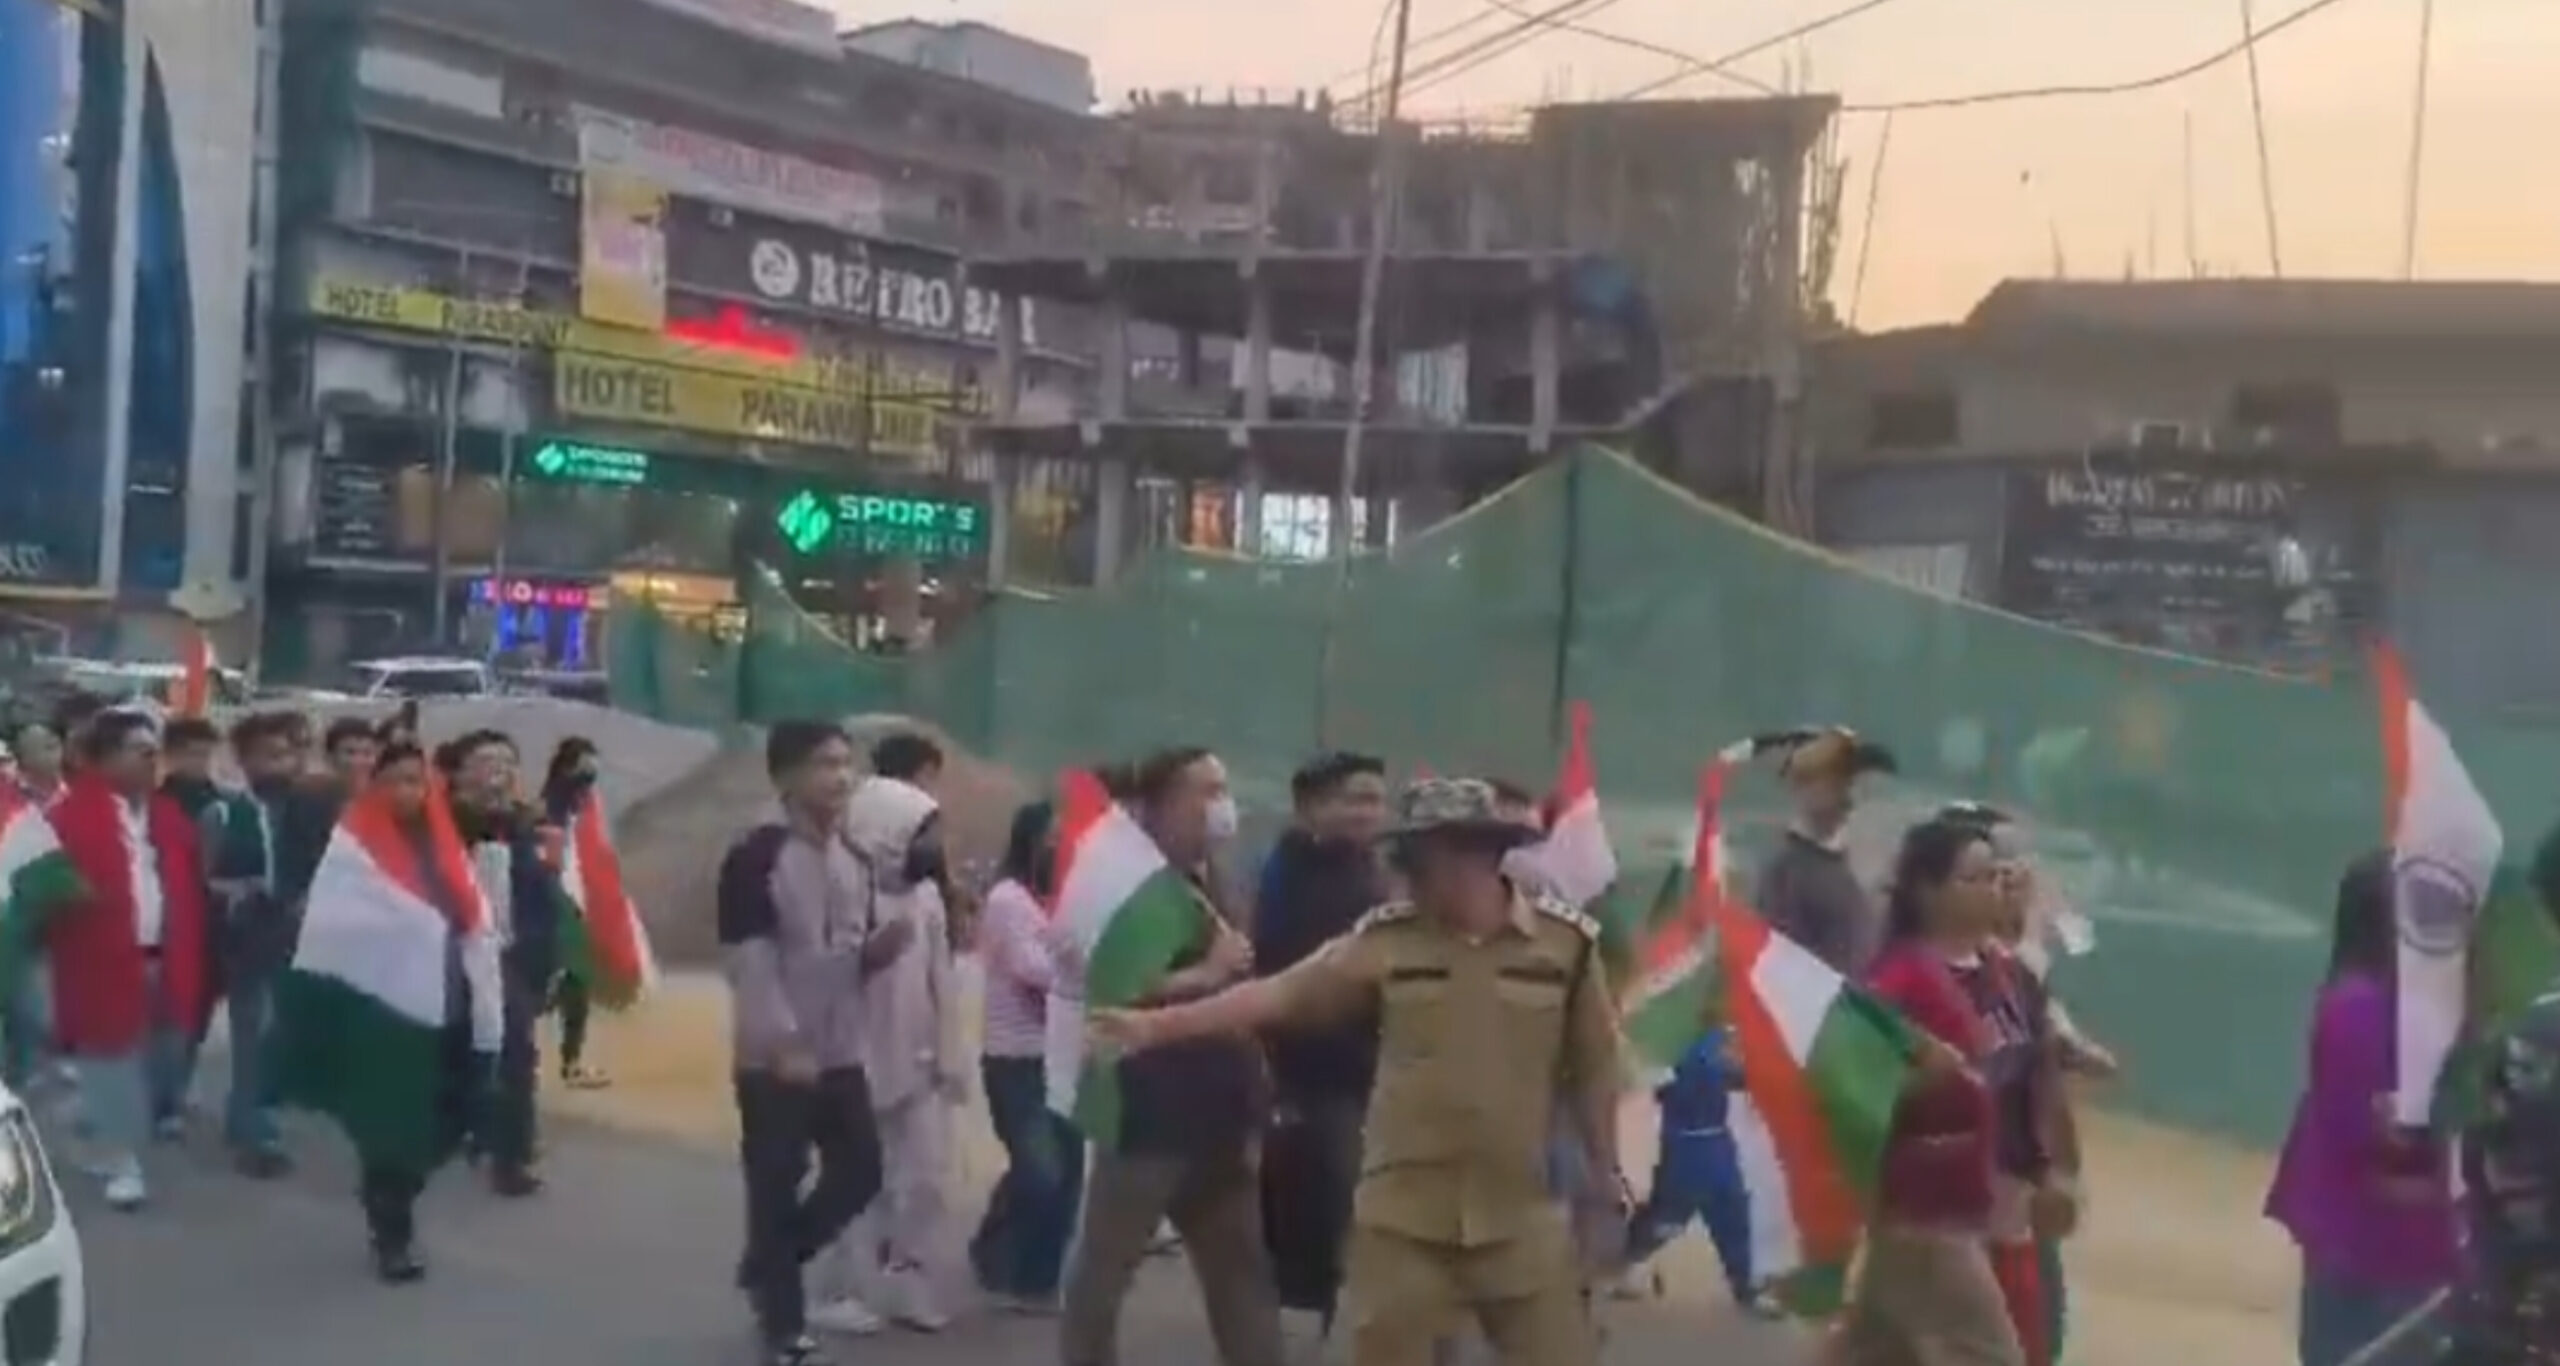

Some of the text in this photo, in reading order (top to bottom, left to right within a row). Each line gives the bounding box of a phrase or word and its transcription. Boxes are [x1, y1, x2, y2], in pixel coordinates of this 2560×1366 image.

[327, 286, 400, 318] HOTEL
[811, 253, 951, 327] RETRO
[565, 364, 676, 415] HOTEL
